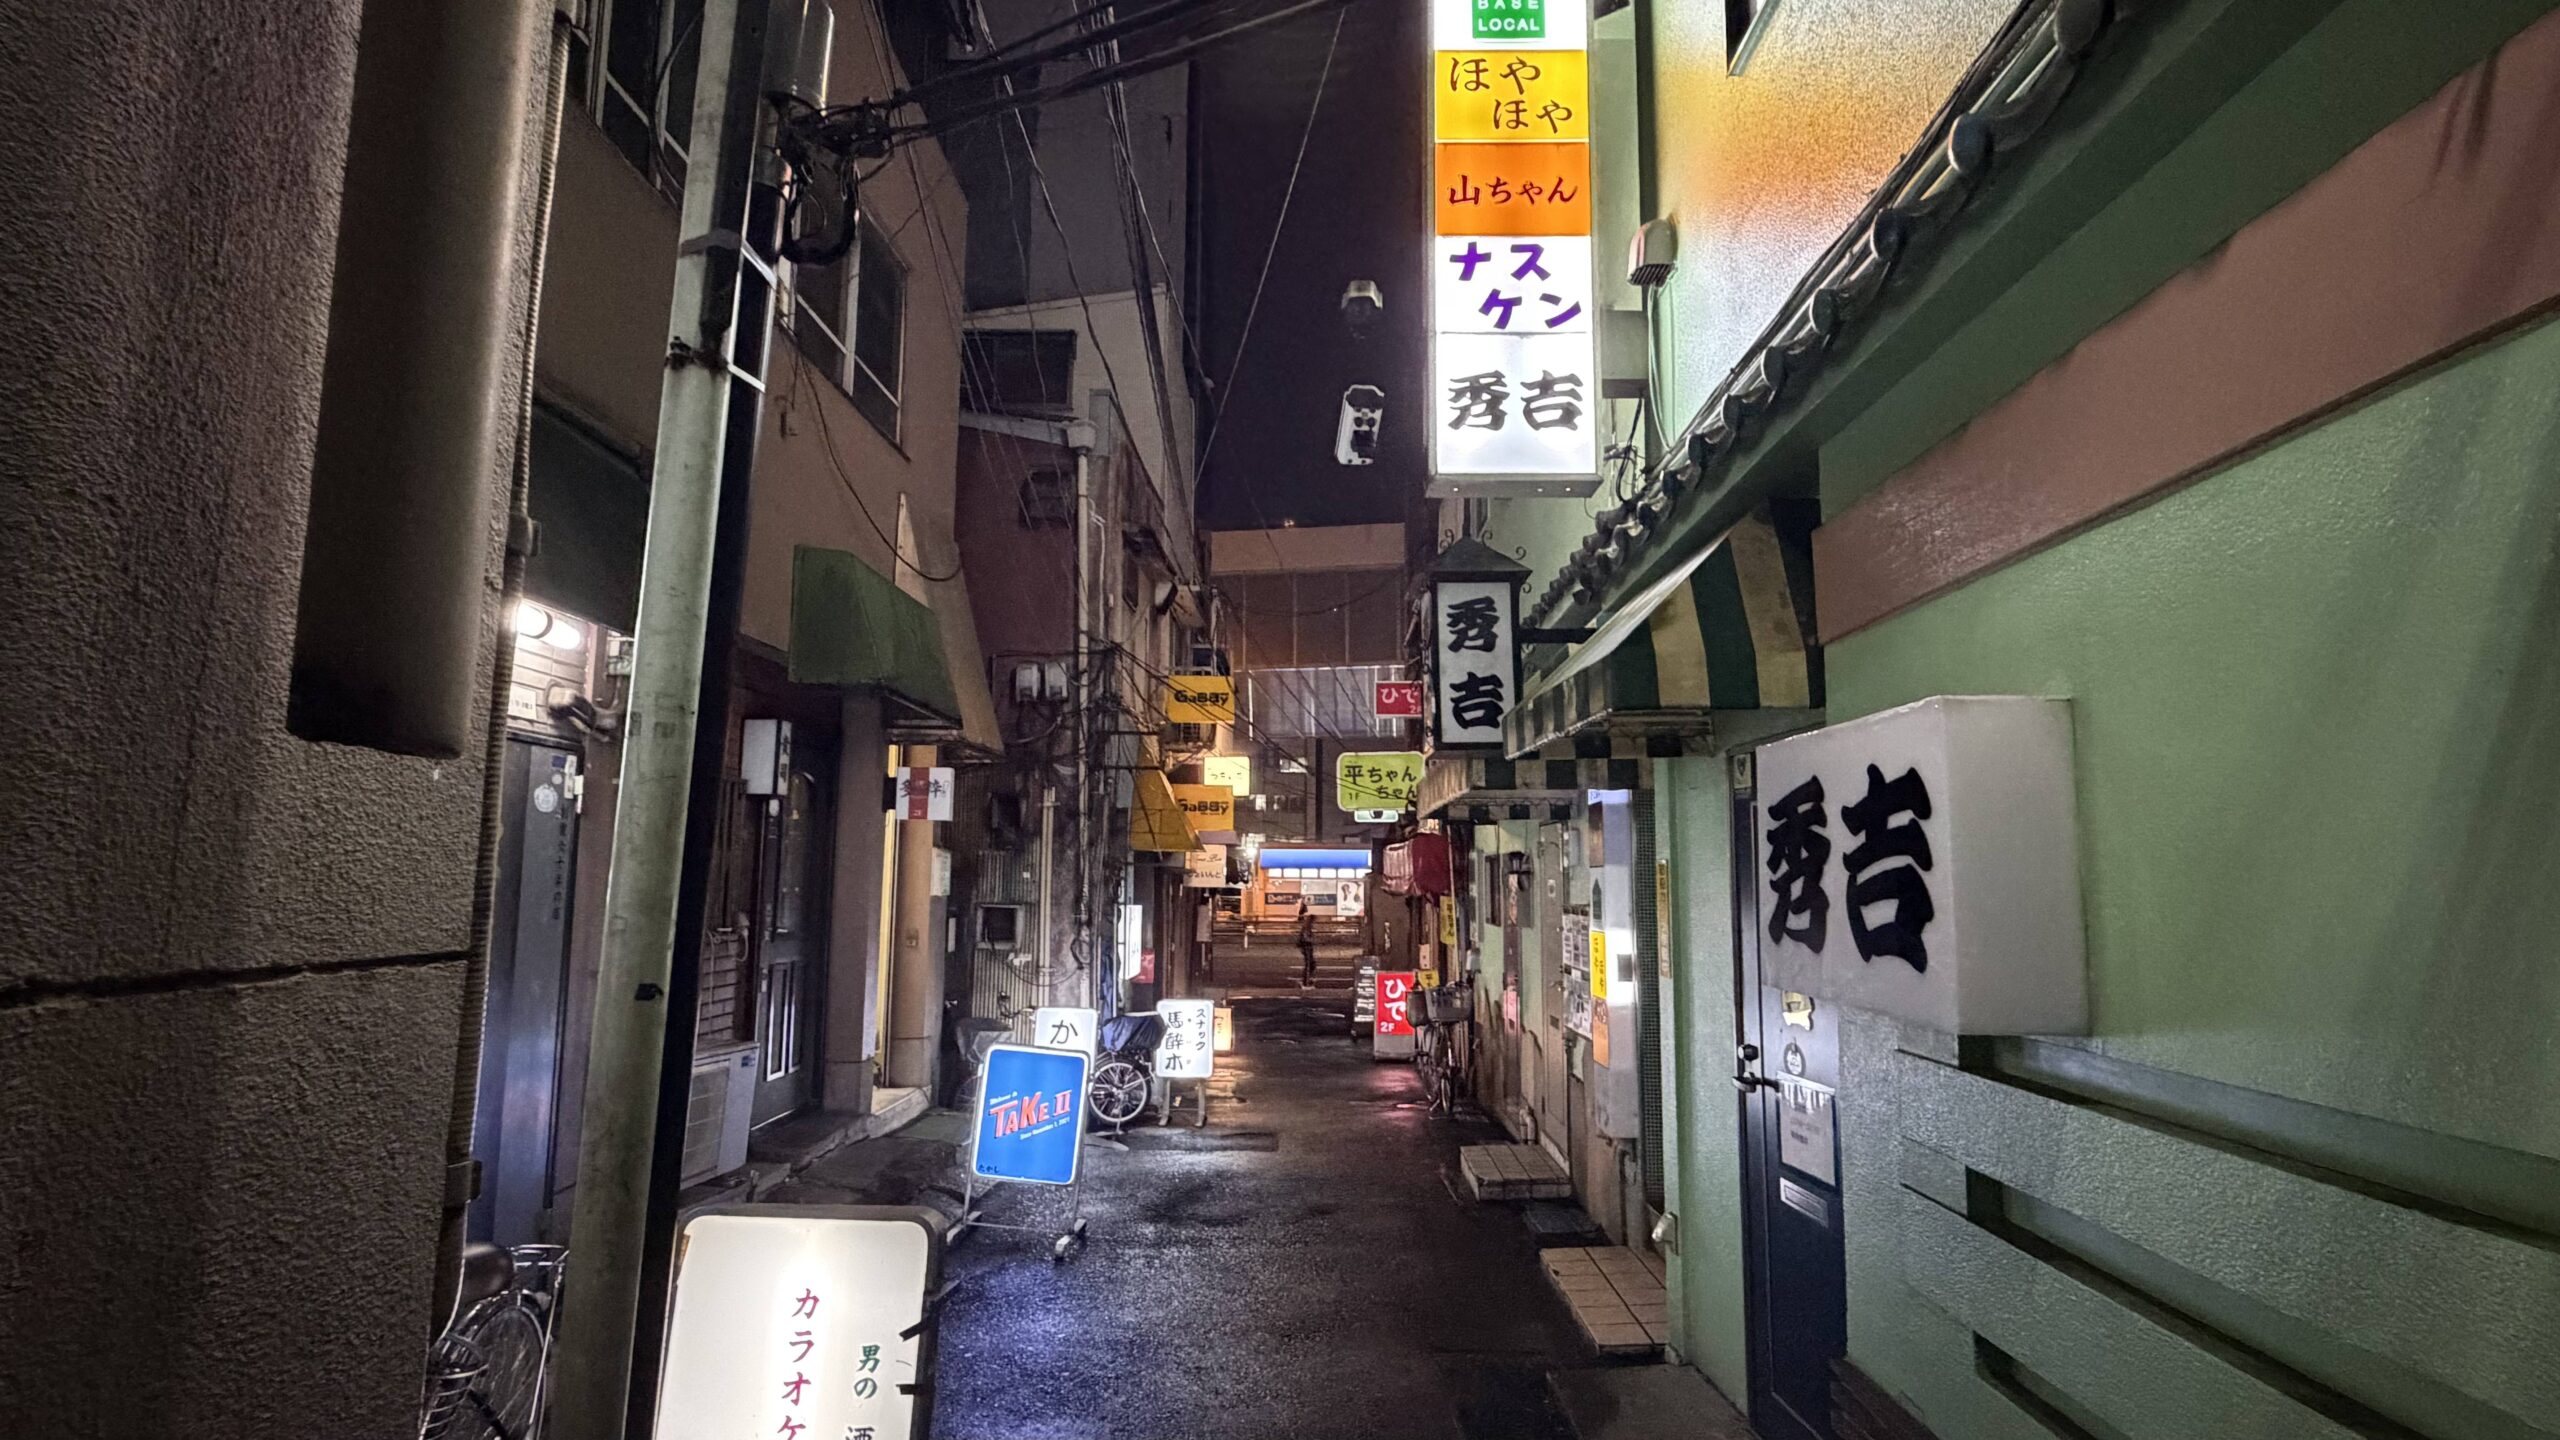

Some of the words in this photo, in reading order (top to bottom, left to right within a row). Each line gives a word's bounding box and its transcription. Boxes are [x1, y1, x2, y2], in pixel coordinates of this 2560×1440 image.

[1478, 0, 1540, 10] BASE
[1478, 18, 1540, 31] LOCAL
[1450, 57, 1541, 94] ほや
[1493, 99, 1573, 134] ほや
[1449, 174, 1578, 206] 山ちゃん
[1450, 241, 1551, 281] ナス
[1478, 288, 1582, 330] ケン
[1448, 370, 1584, 431] 秀吉
[1446, 595, 1504, 730] 秀吉
[1343, 765, 1418, 785] 平ちゃん
[1766, 763, 1936, 974] 秀吉
[1384, 978, 1407, 1021] ひで
[1050, 1019, 1078, 1044] か
[1195, 1008, 1207, 1051] スナック
[1380, 1021, 1395, 1032] 2F
[777, 1288, 820, 1440] カラオケ
